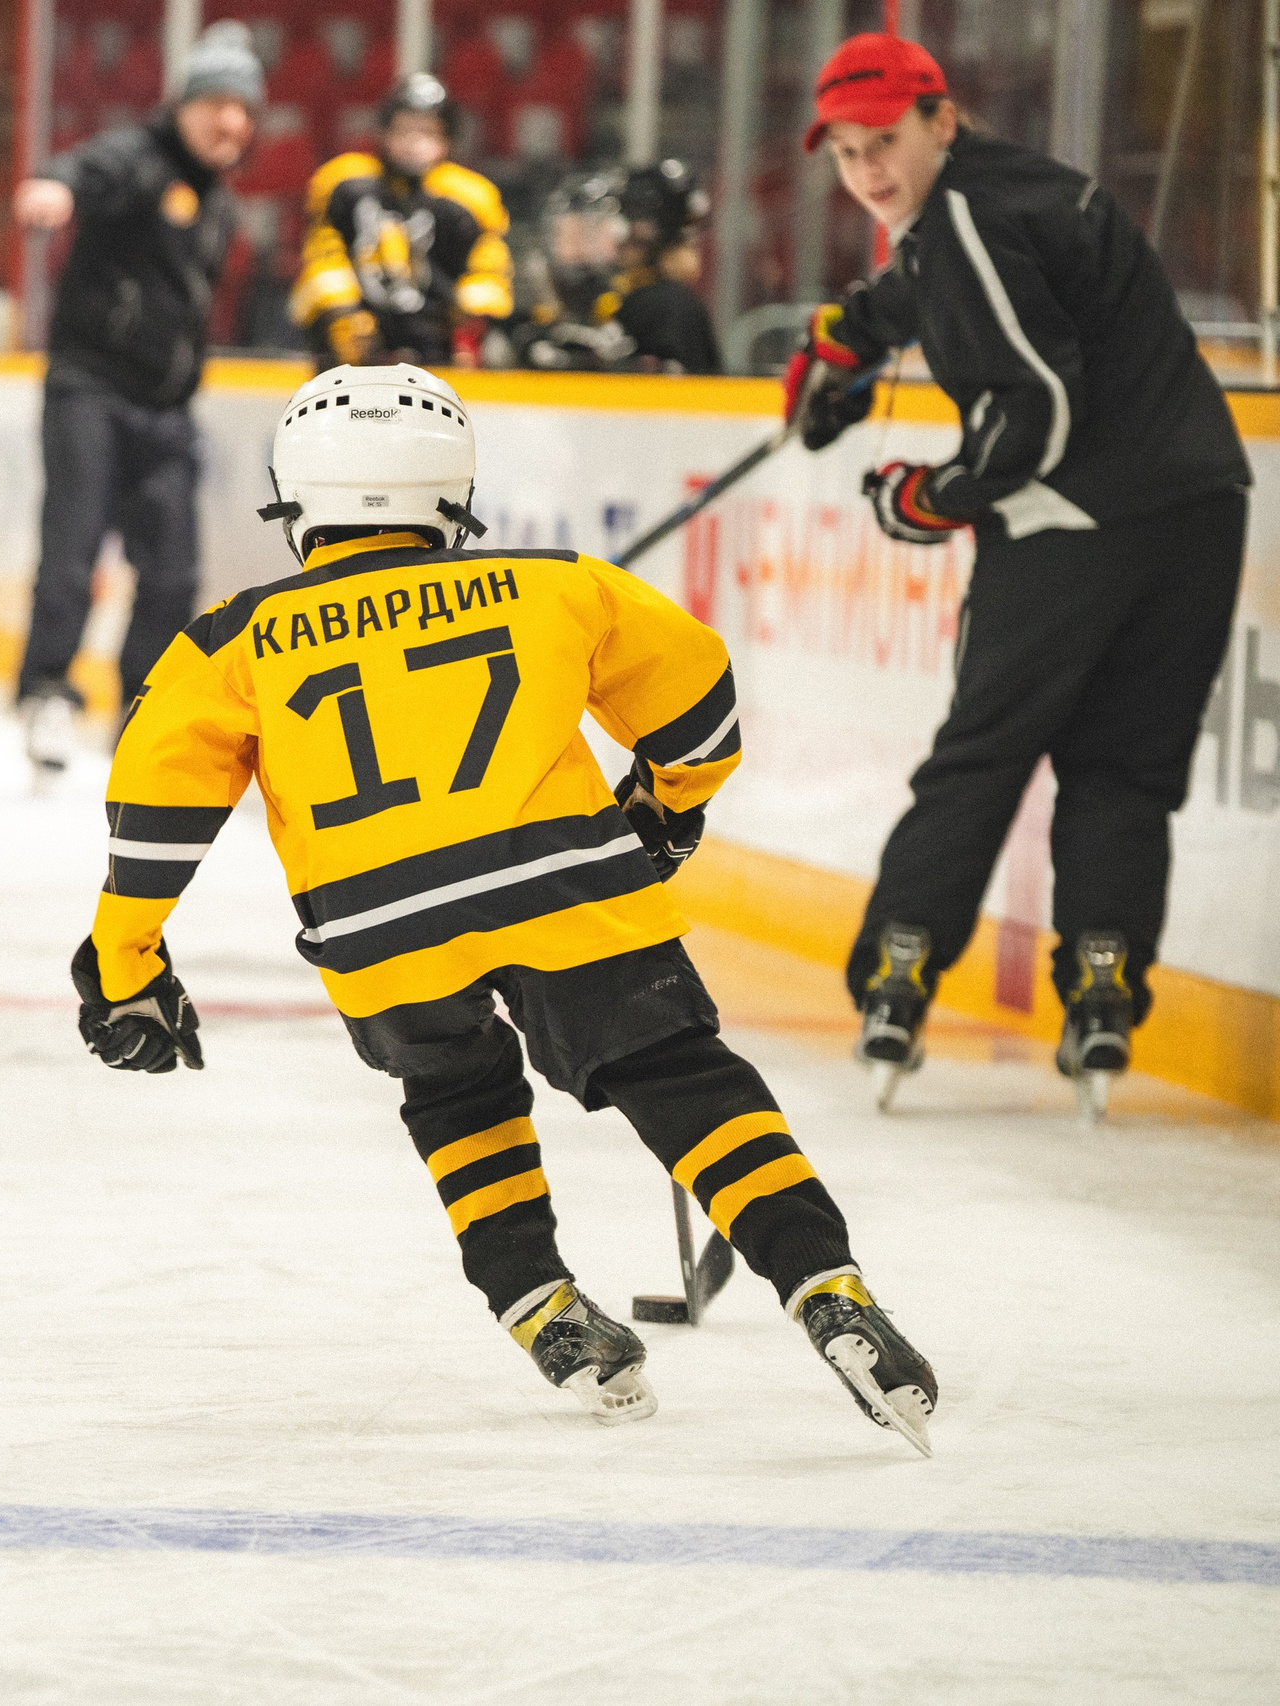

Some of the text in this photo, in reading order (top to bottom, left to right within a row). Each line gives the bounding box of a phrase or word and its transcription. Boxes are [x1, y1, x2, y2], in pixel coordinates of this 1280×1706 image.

[350, 408, 398, 419] Reebok
[252, 568, 520, 660] КАВАРДИН
[285, 624, 521, 831] 17
